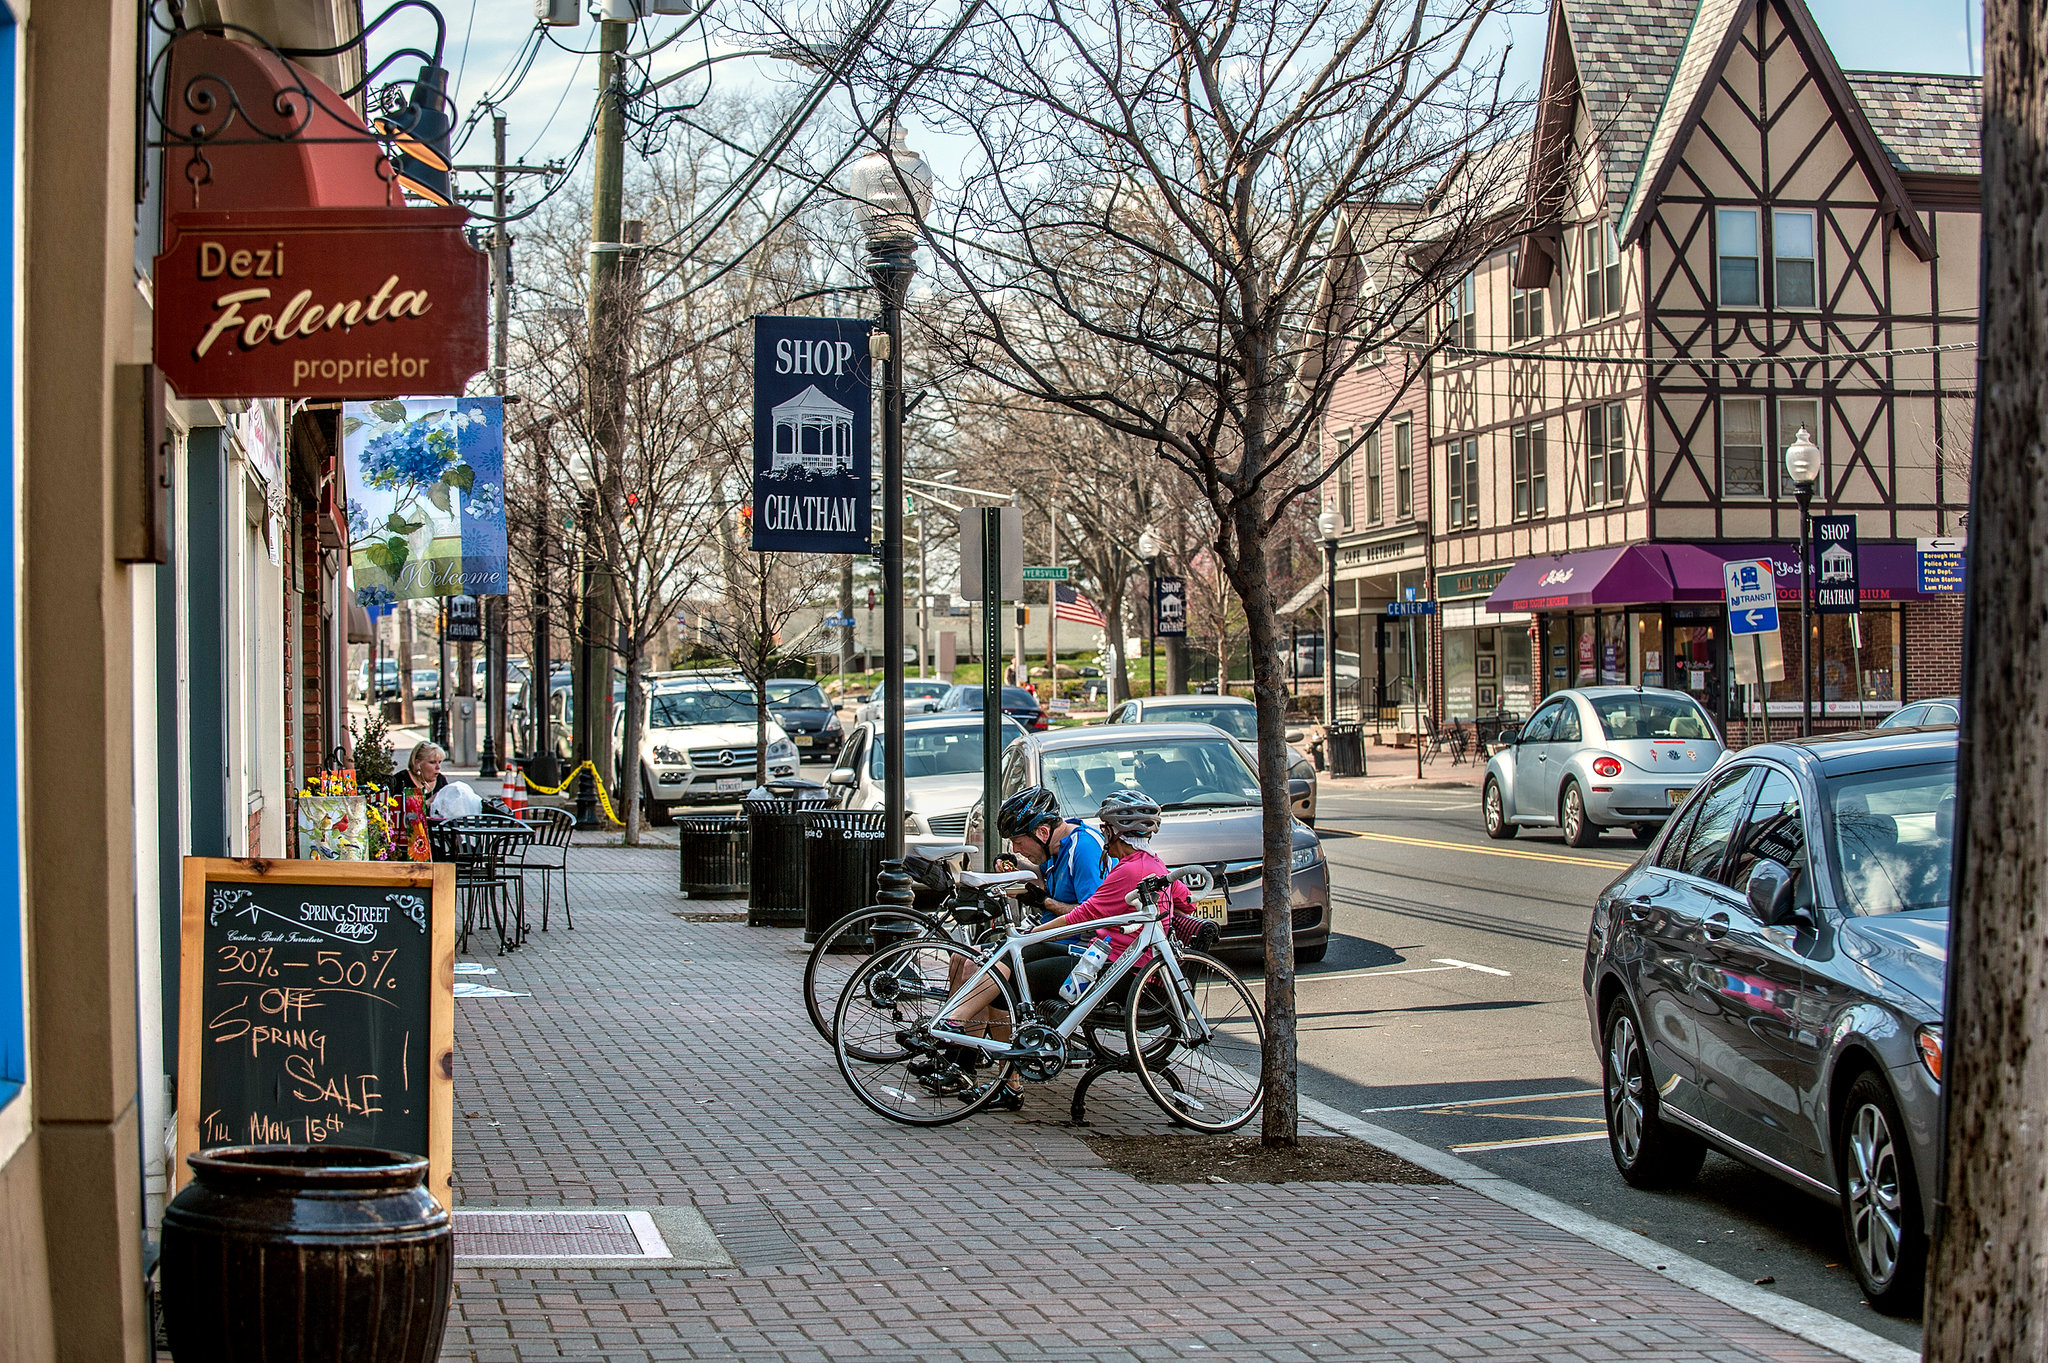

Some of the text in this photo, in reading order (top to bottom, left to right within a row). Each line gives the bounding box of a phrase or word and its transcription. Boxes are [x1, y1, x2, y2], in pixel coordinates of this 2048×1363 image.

[200, 241, 284, 278] Dezi
[196, 274, 433, 358] Folenta
[775, 337, 853, 376] SHOP
[293, 351, 430, 387] proprietor
[764, 493, 858, 532] CHATHAM
[1821, 524, 1850, 541] SHOP
[400, 559, 501, 591] Welcome
[1161, 581, 1182, 593] SHOP
[1818, 588, 1855, 606] CHATHAM
[1740, 592, 1772, 604] TRANSIT
[1387, 602, 1423, 616] CENTER
[853, 829, 885, 840] Recycle
[300, 902, 391, 923] SPRING STREET
[226, 929, 324, 944] Custom Built Furniture
[335, 920, 374, 939] dezigns
[217, 945, 279, 978] 30%
[316, 948, 399, 990] 50%
